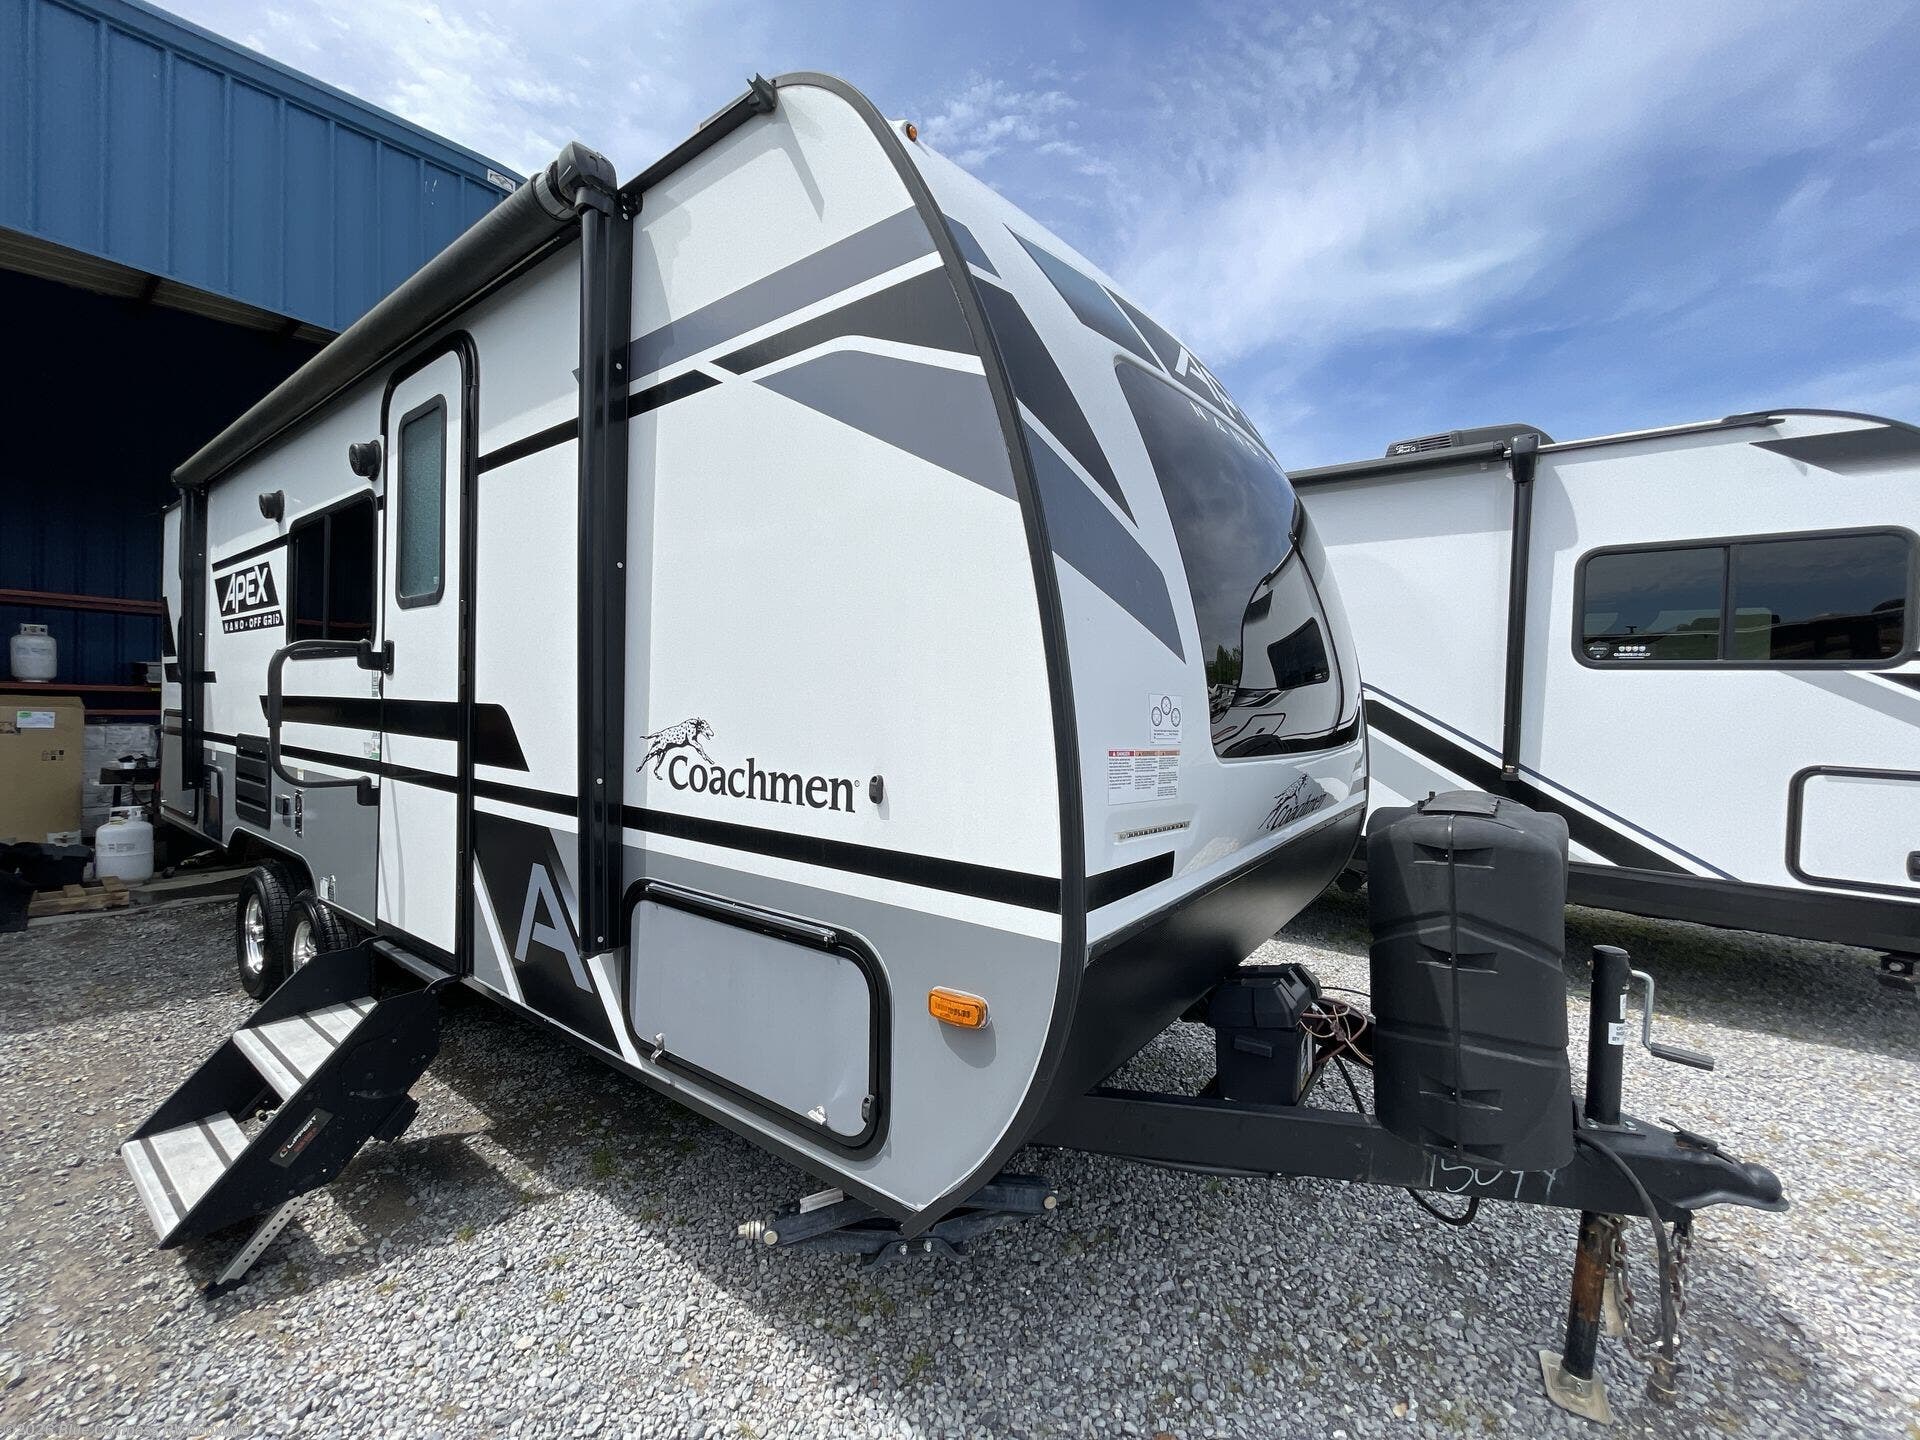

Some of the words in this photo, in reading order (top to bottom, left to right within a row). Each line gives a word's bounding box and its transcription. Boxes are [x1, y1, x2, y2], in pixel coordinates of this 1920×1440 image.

[222, 565, 269, 614] APEX
[224, 620, 244, 632] NANO
[249, 617, 262, 628] OFF
[263, 613, 281, 626] GRID
[668, 754, 856, 814] Coachmen
[514, 862, 594, 994] A
